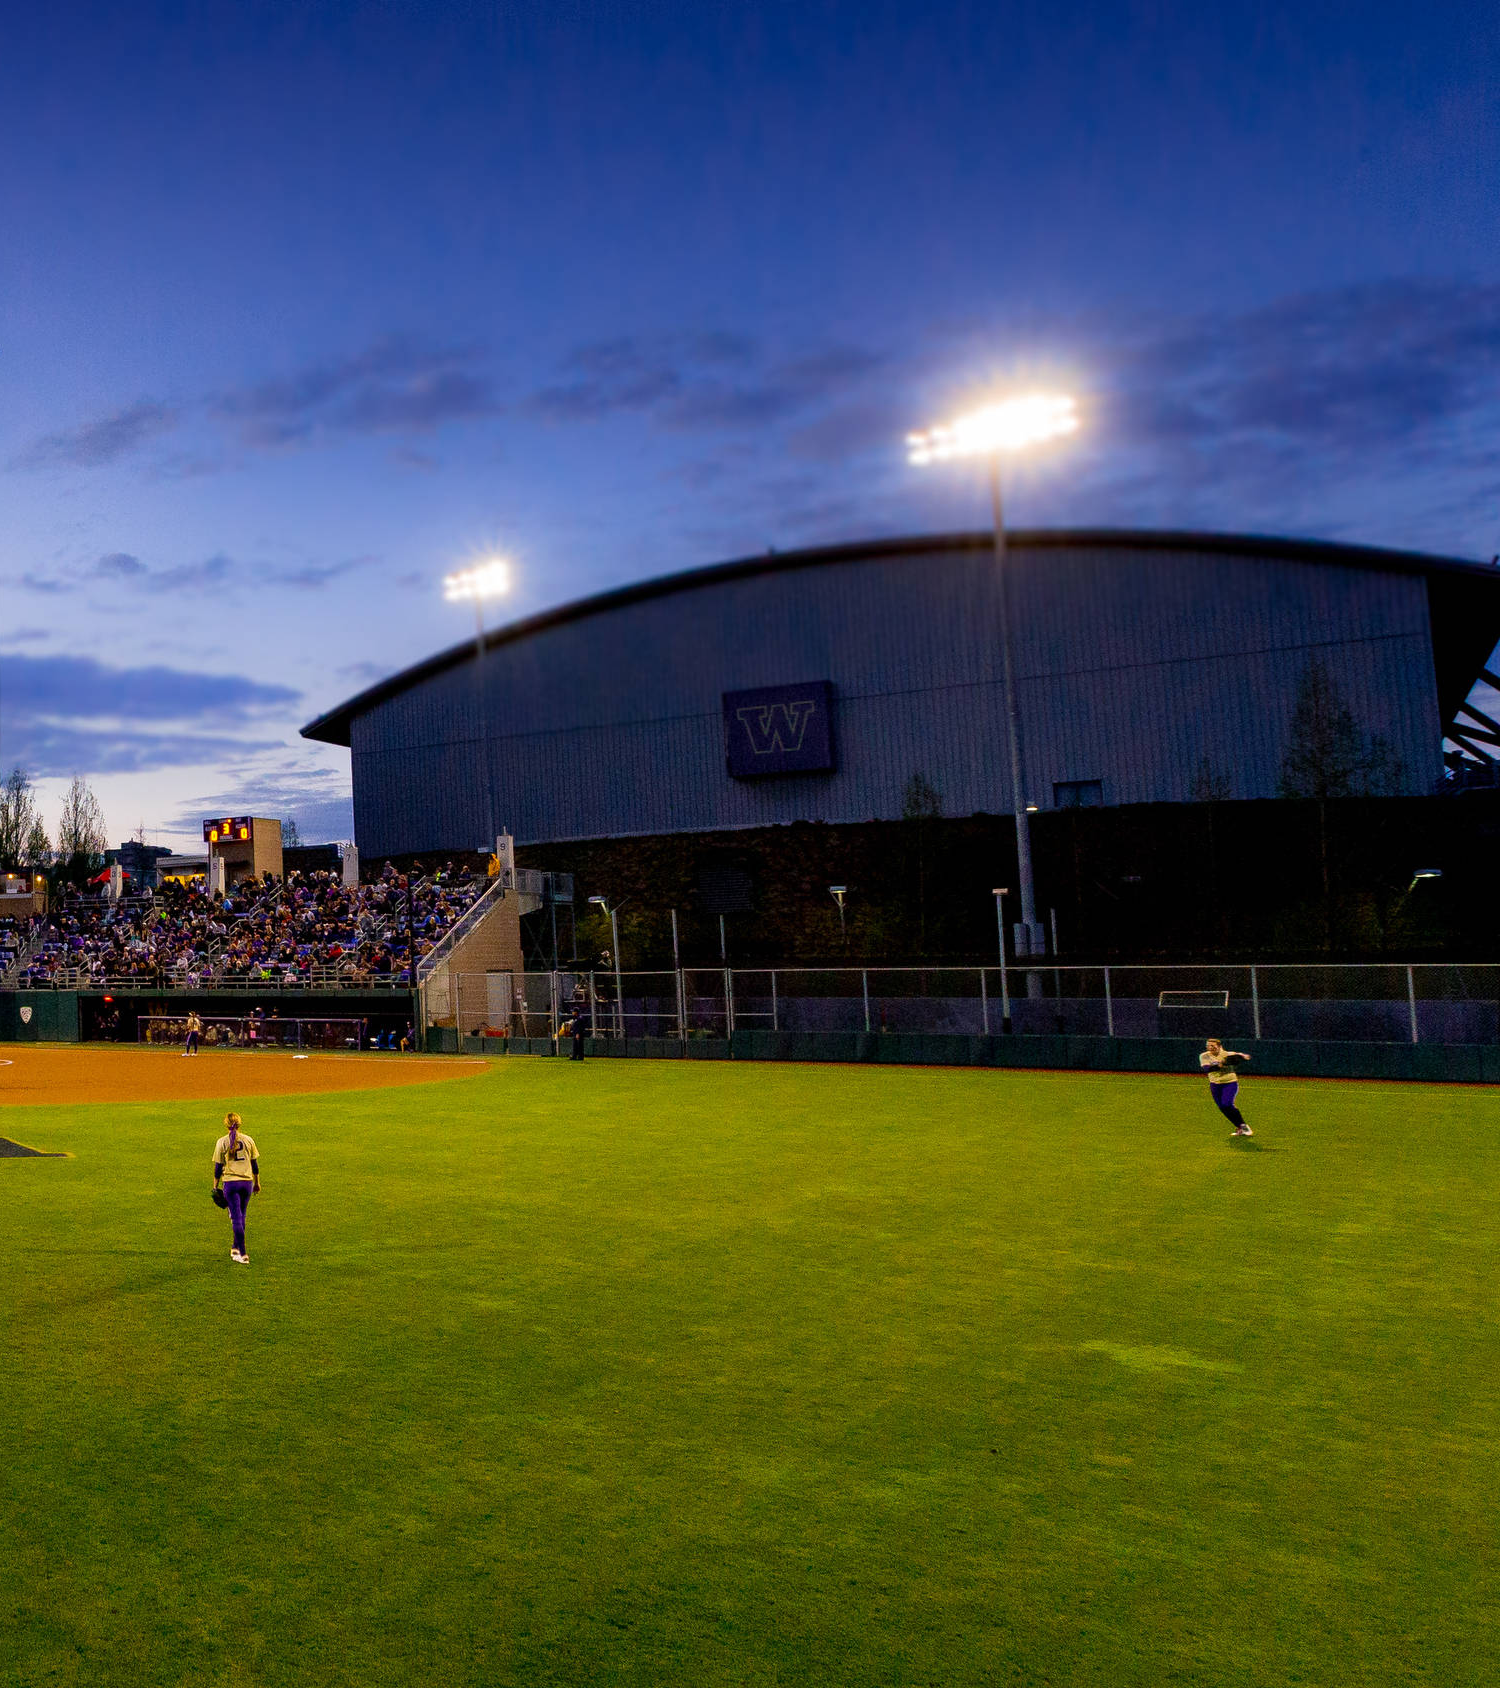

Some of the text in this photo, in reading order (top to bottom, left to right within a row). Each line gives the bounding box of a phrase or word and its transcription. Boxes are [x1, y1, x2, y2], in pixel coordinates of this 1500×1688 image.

[737, 701, 815, 754] W
[223, 823, 230, 834] 3
[240, 827, 248, 839] 0
[211, 830, 218, 841] 0
